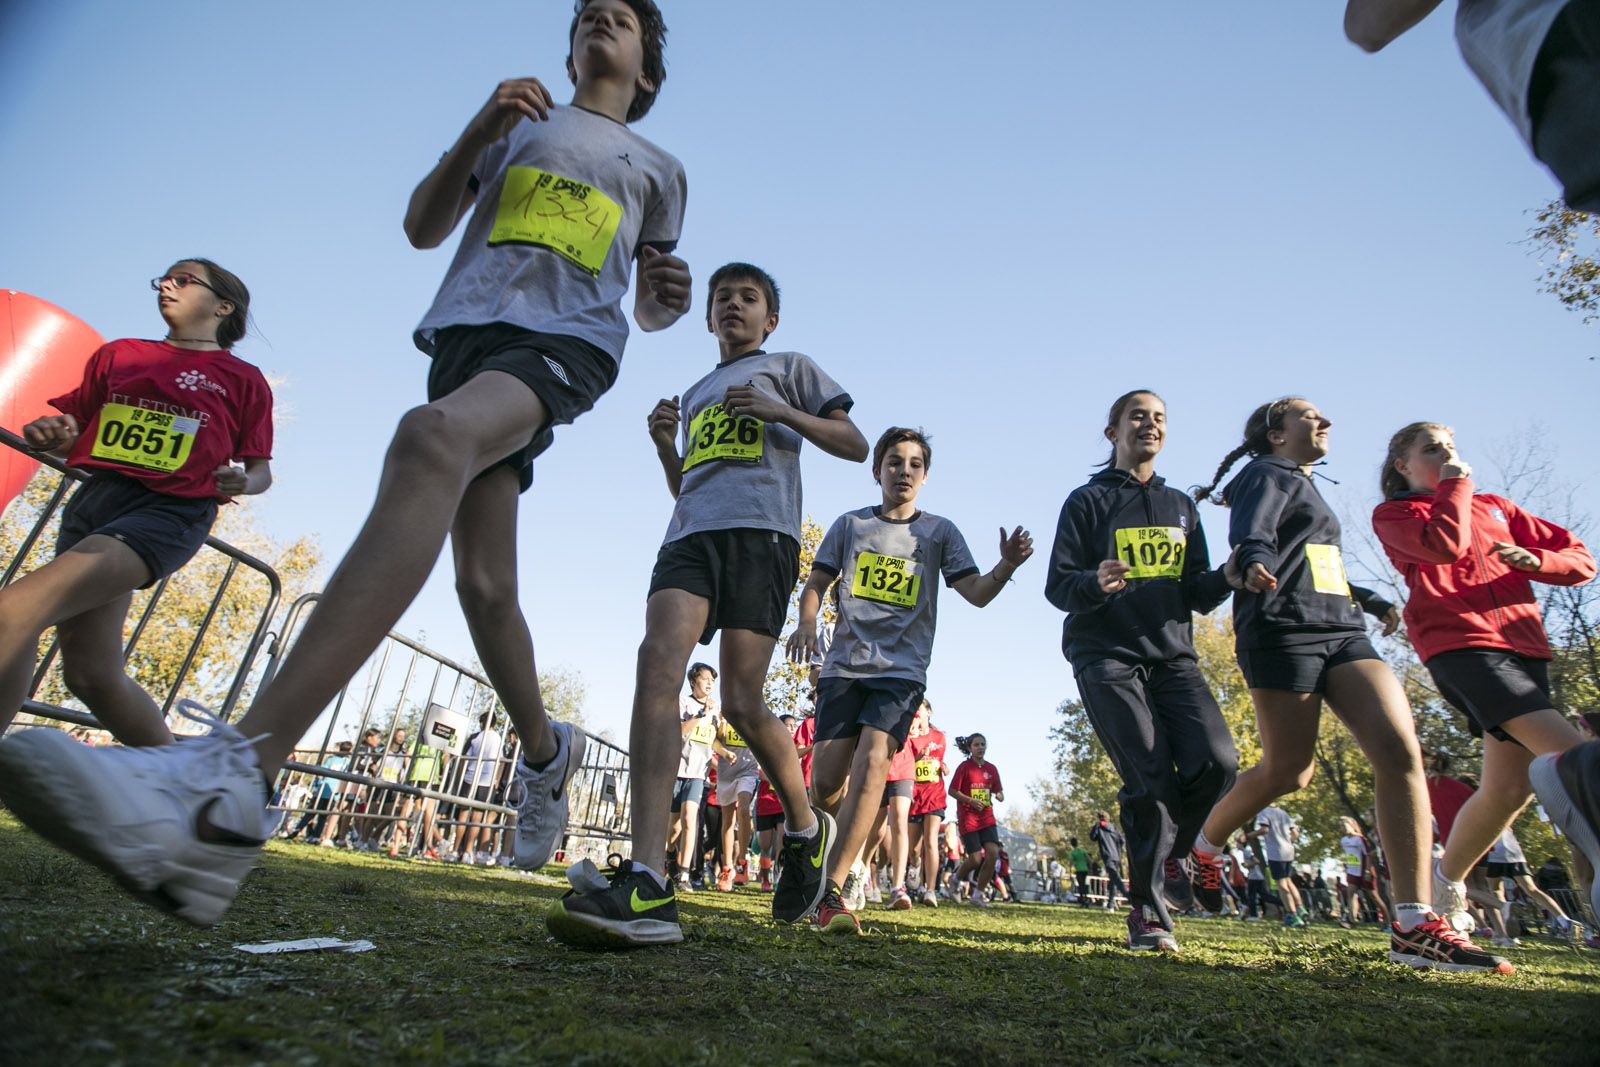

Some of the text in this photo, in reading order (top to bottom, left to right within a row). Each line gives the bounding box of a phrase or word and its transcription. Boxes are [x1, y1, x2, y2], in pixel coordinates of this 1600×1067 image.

[513, 176, 609, 241] 1324
[101, 420, 184, 459] 0651
[860, 565, 914, 596] 1321
